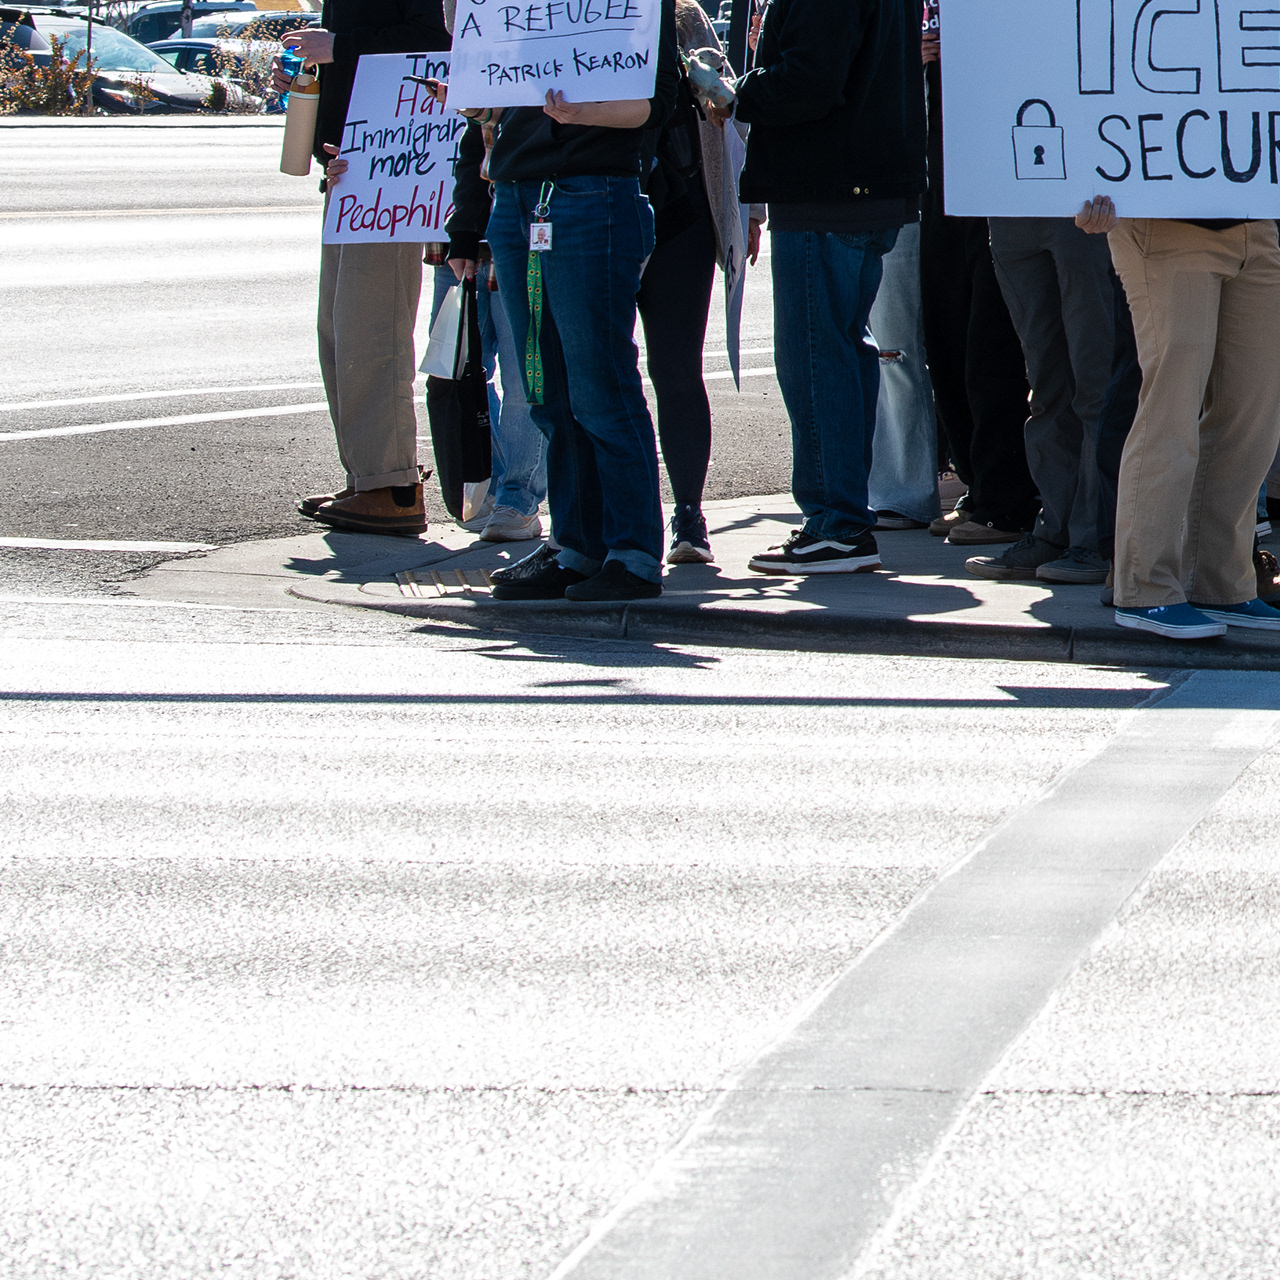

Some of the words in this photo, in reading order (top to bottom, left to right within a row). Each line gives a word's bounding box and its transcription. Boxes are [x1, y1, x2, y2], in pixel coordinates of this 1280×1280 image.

[461, 13, 482, 39] A
[481, 59, 563, 87] -PATRICK
[573, 47, 649, 77] KEARON
[368, 150, 436, 180] more
